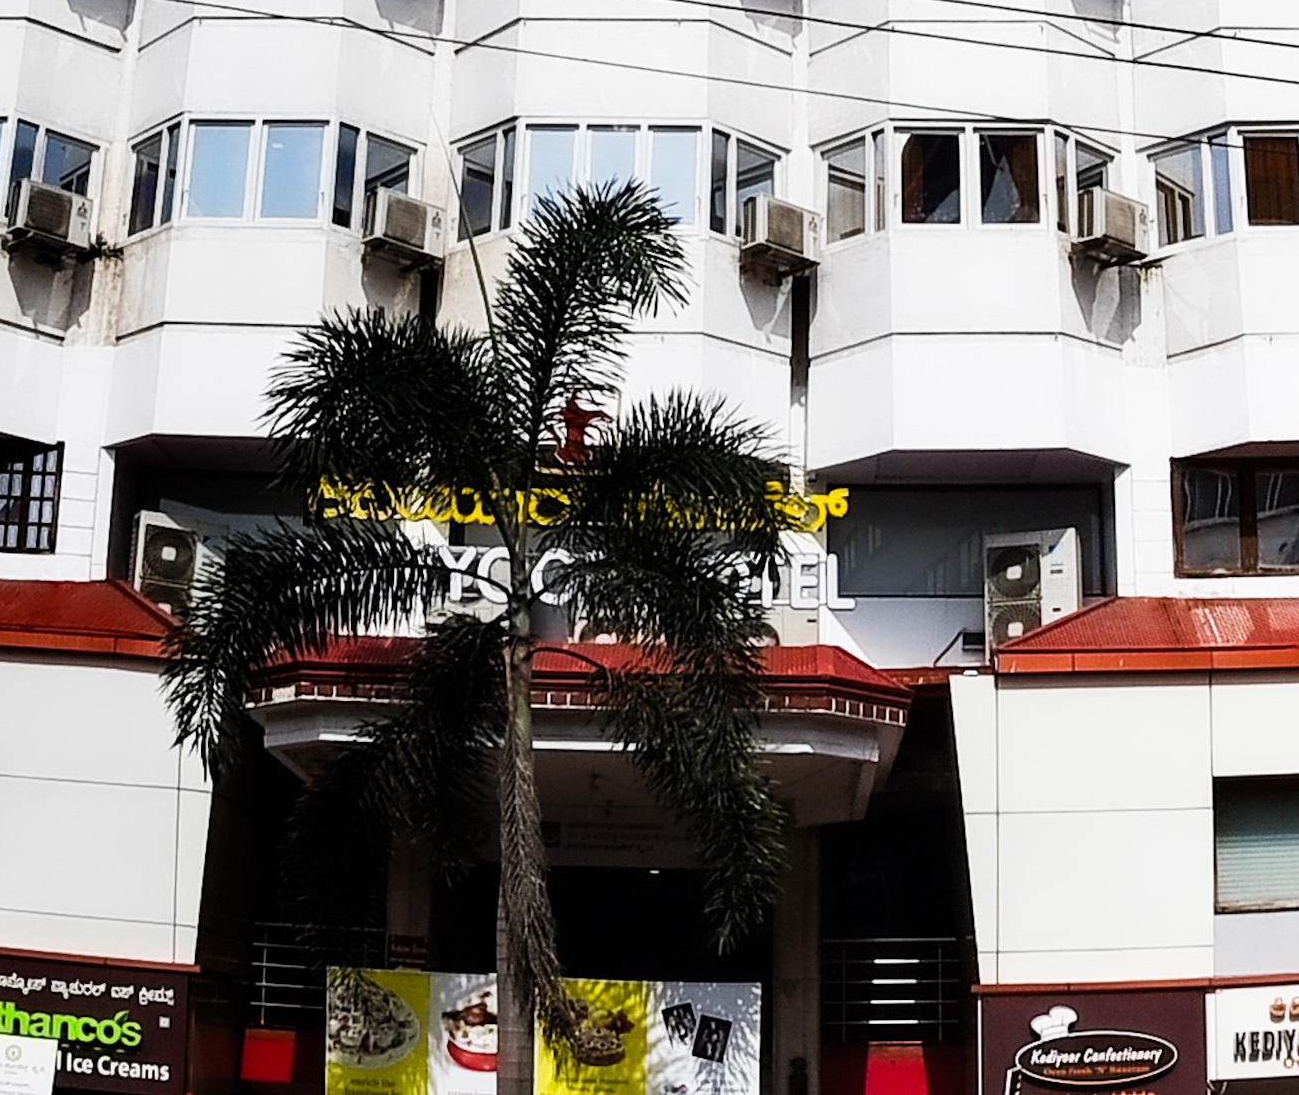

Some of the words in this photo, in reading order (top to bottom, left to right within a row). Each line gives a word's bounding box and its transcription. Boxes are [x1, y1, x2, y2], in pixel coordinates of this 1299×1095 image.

[66, 1052, 93, 1074] Ice
[96, 1055, 170, 1082] Creams
[1030, 1049, 1081, 1068] Kediyoor
[1083, 1047, 1163, 1065] Confectionery
